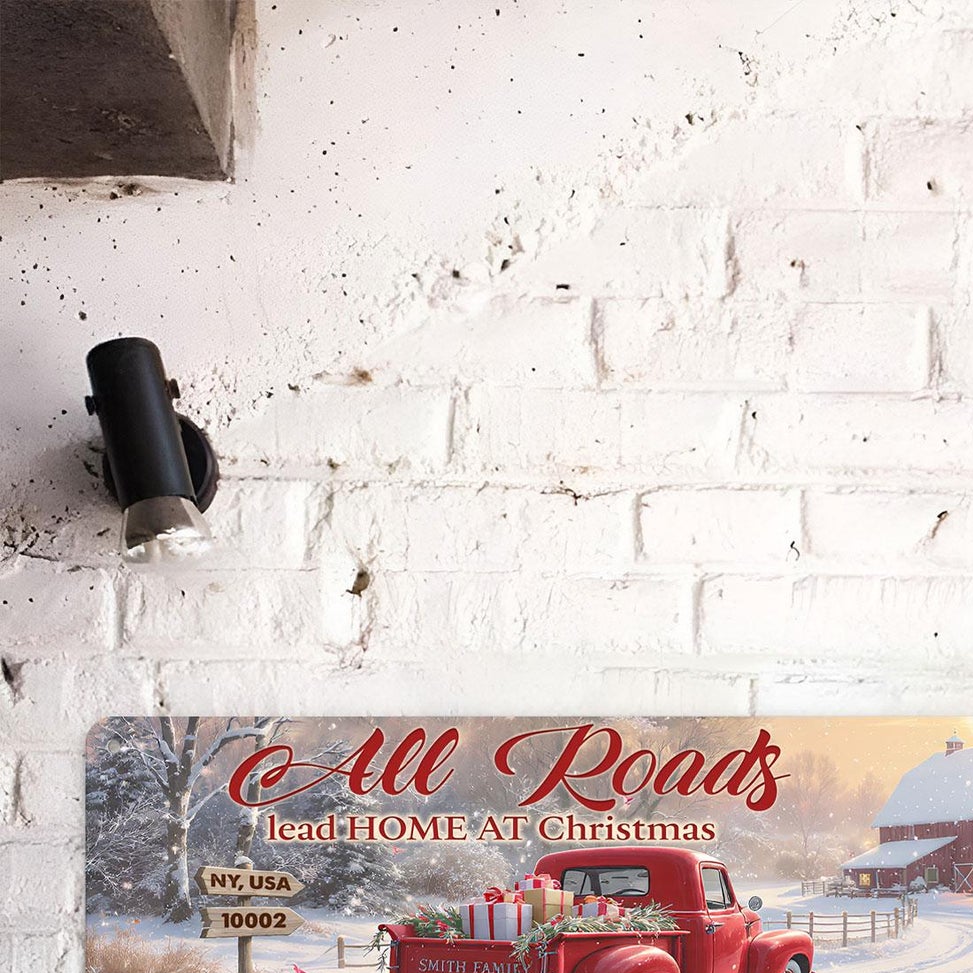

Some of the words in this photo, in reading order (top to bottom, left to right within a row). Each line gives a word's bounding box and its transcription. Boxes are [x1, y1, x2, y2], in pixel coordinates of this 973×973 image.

[228, 727, 459, 807] All
[494, 724, 791, 811] Roads
[267, 814, 337, 841] lead
[346, 816, 467, 841] HOME
[476, 816, 529, 841] AT
[538, 814, 716, 841] Christmas
[210, 873, 245, 891] NY,
[249, 876, 292, 891] USA
[221, 912, 287, 929] 10002
[418, 958, 466, 973] SMITH
